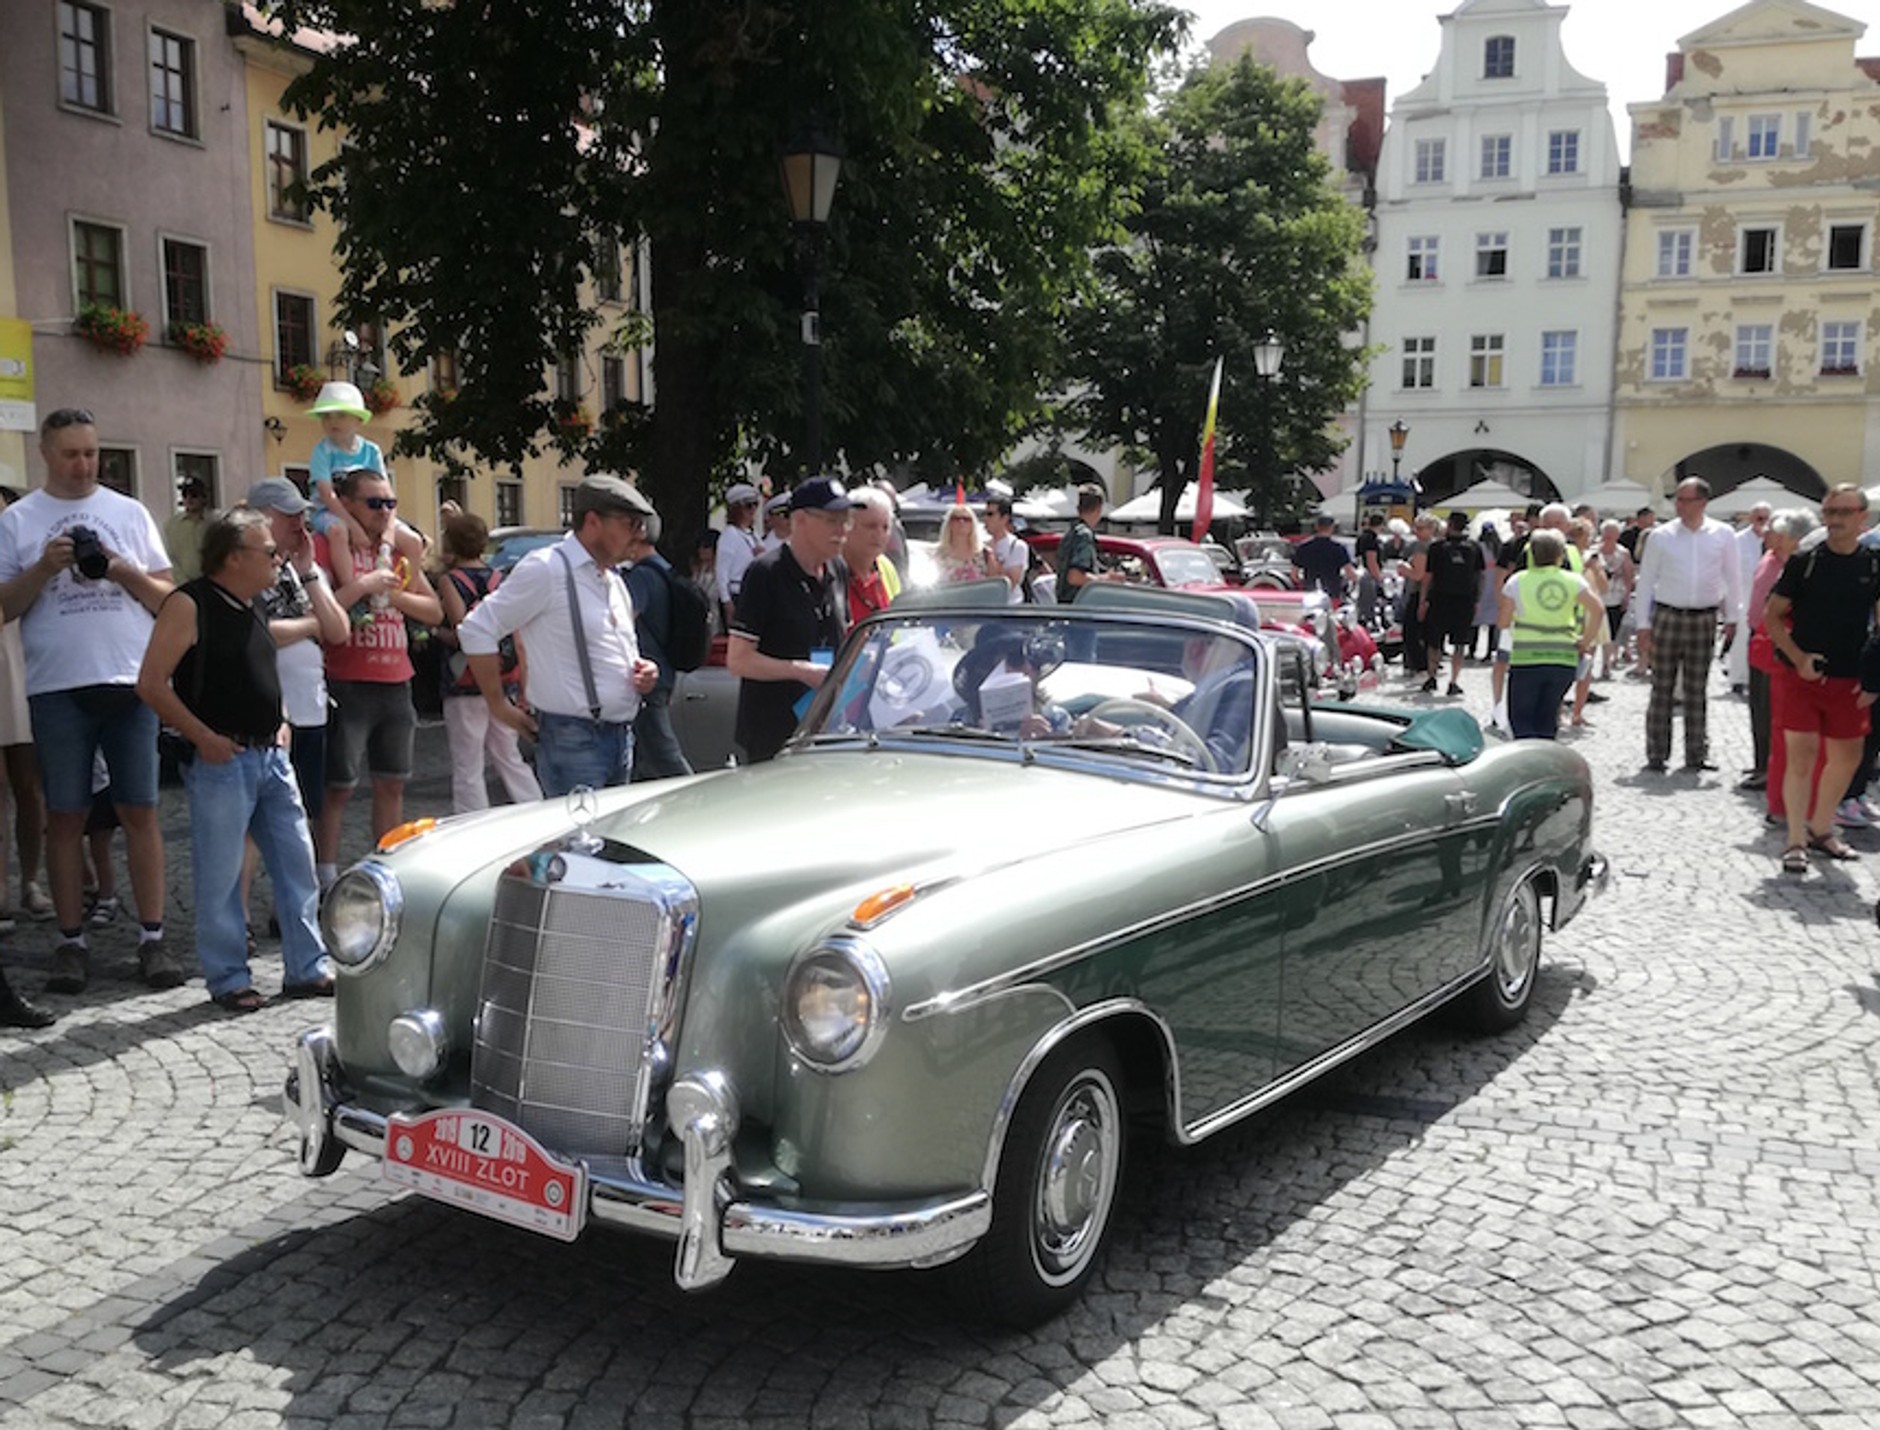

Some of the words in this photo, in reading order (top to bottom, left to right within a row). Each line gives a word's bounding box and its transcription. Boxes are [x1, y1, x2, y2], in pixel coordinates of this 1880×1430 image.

[471, 1123, 490, 1153] 12
[426, 1143, 470, 1174] XVIII
[476, 1158, 530, 1191] ZLOT
